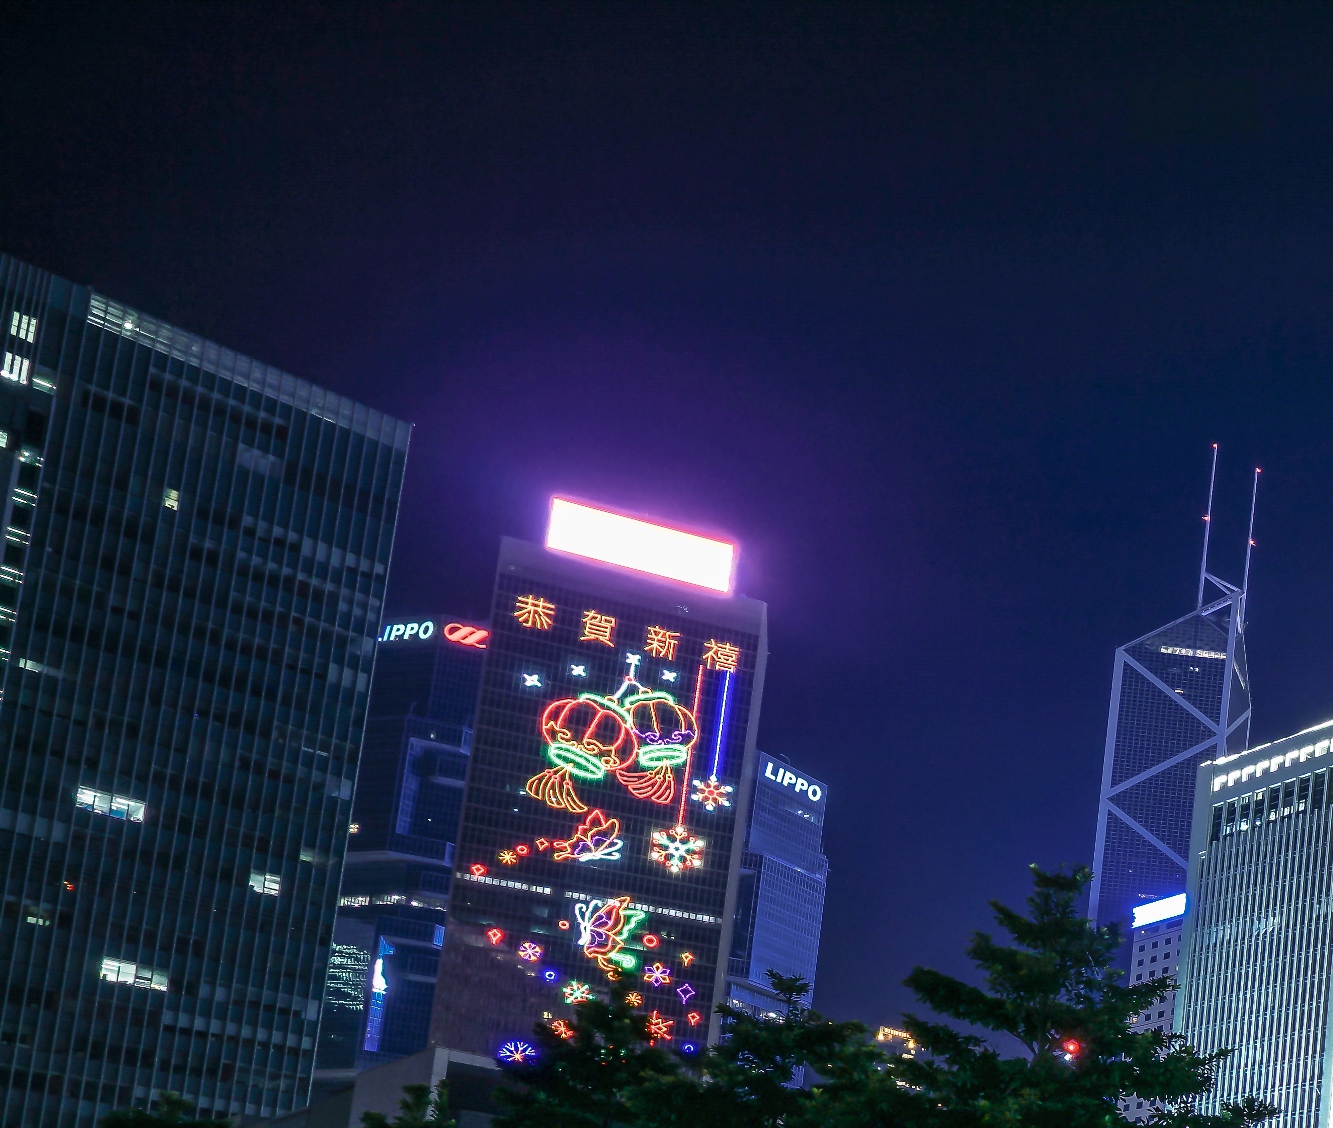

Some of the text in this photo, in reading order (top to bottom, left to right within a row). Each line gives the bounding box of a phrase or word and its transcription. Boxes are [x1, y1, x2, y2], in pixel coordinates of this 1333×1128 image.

[378, 621, 434, 642] IPPO
[513, 594, 741, 674] 恭賀新禧
[764, 761, 822, 801] LIPPO
